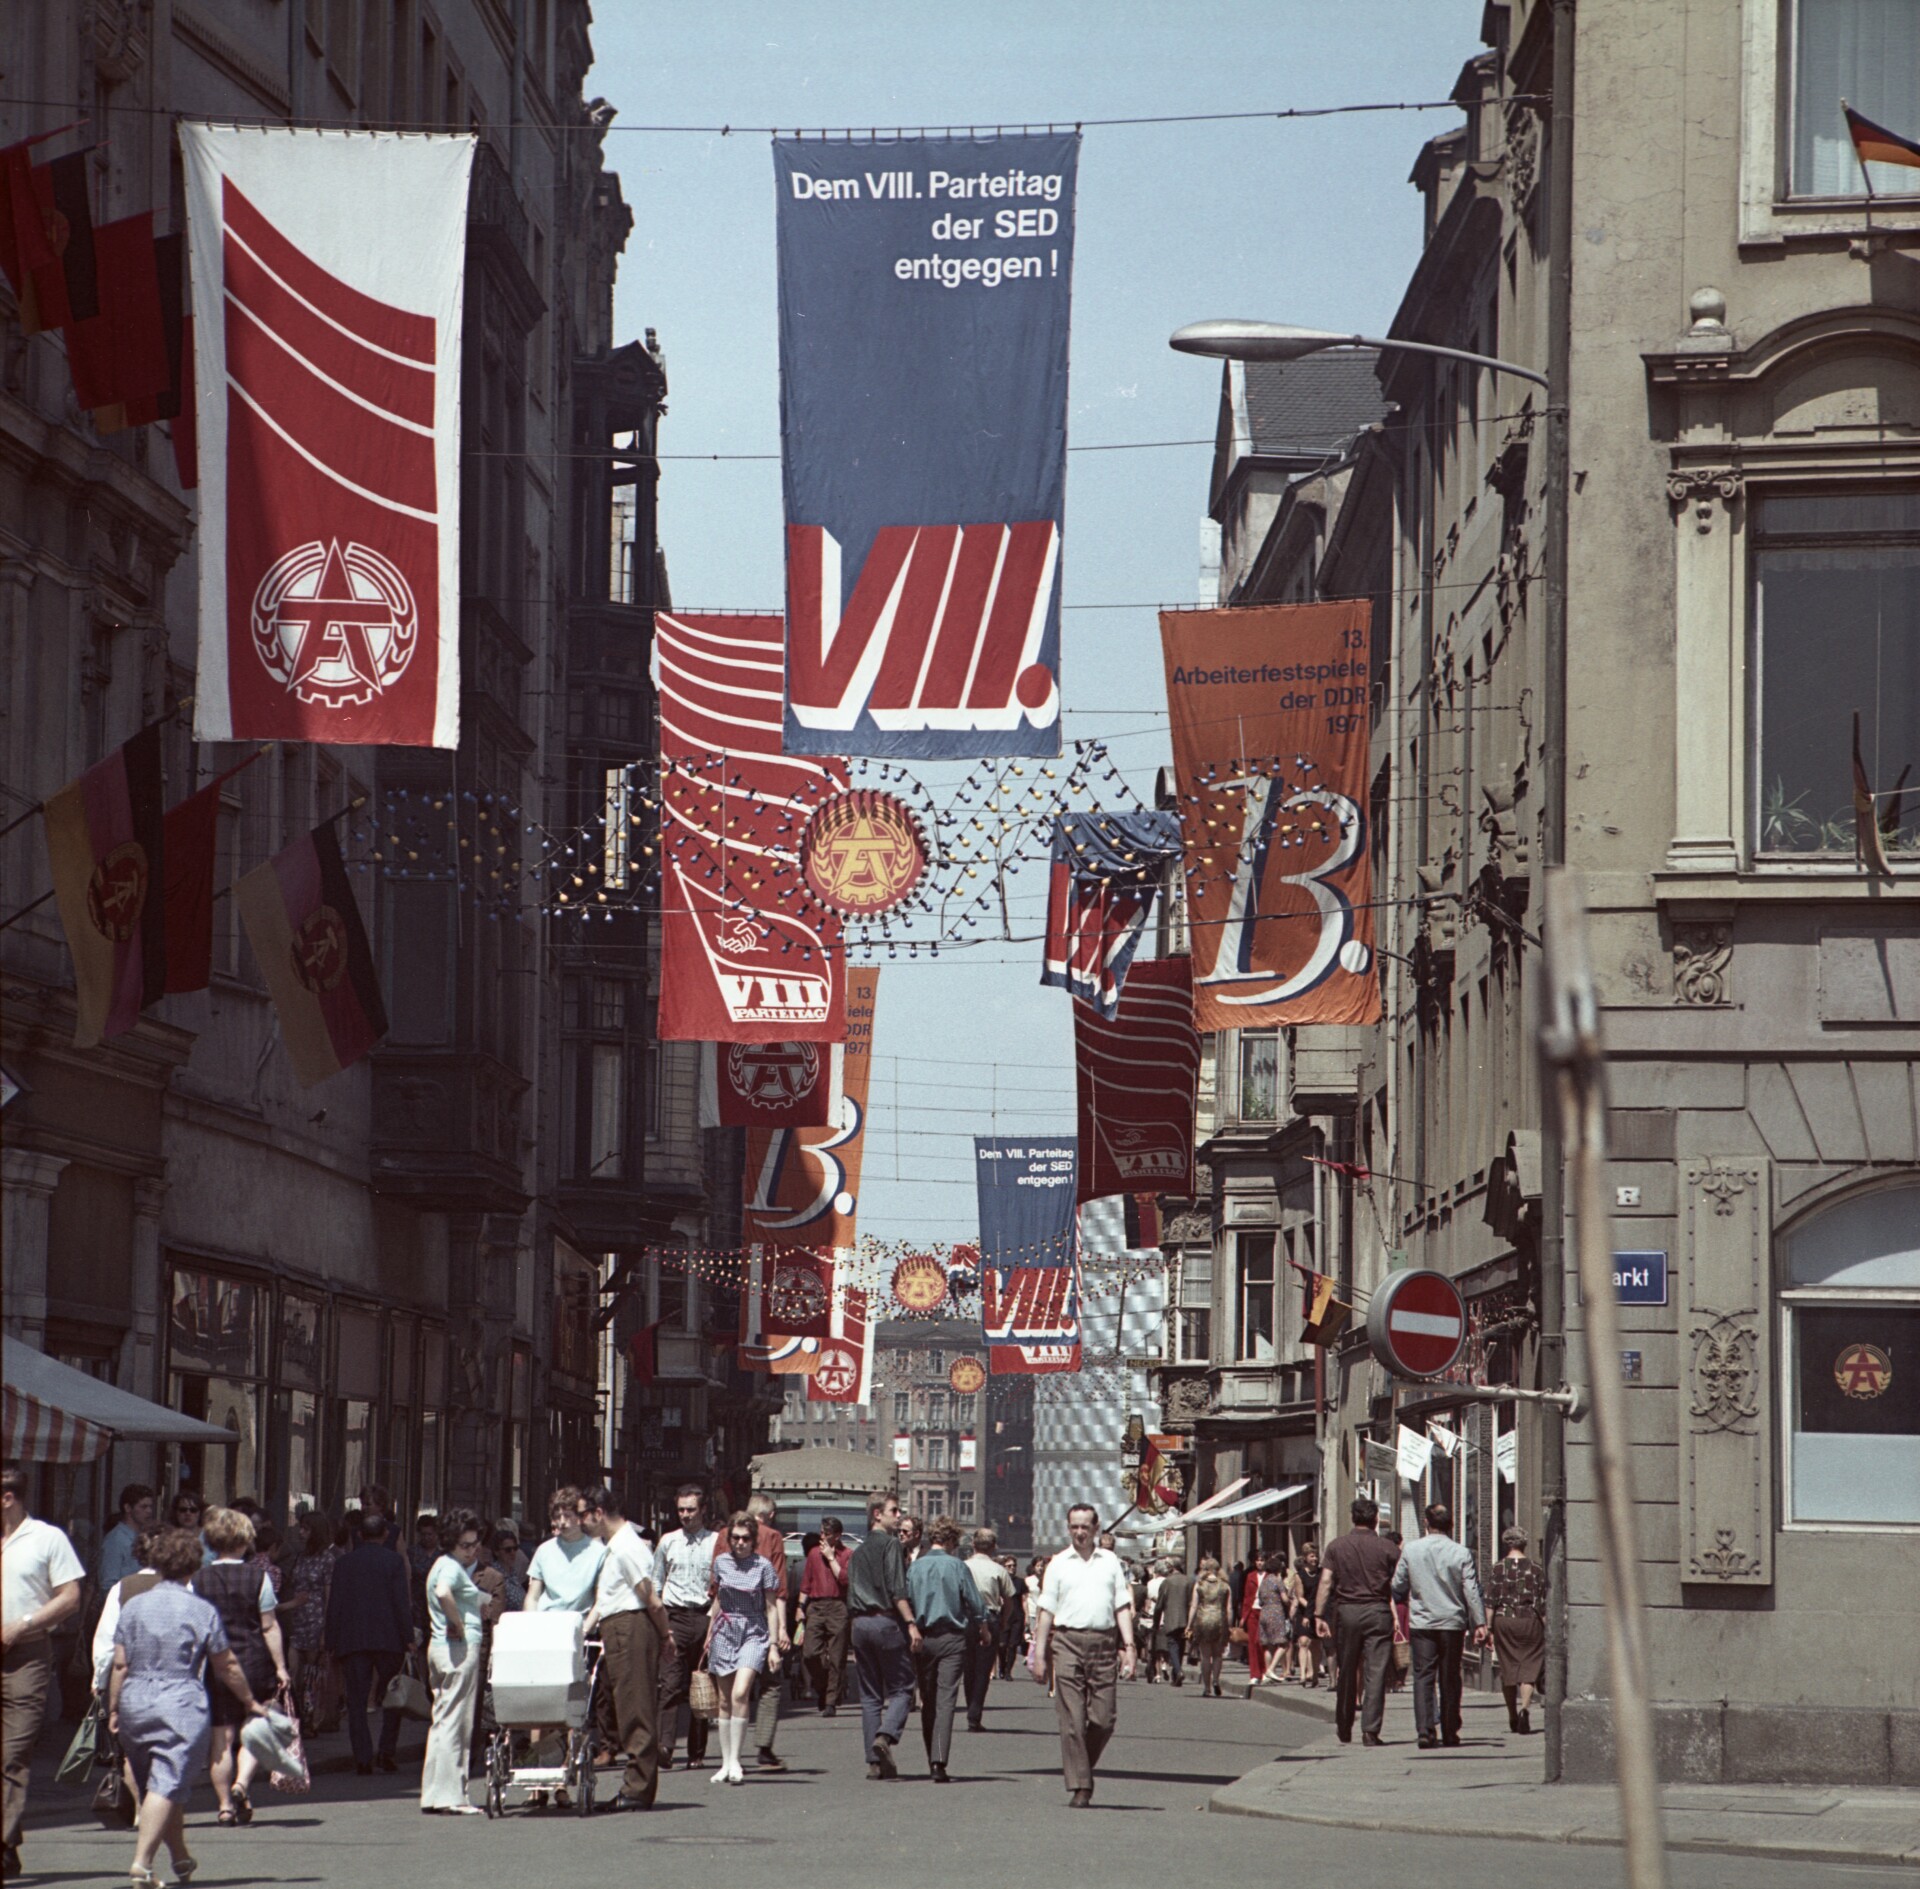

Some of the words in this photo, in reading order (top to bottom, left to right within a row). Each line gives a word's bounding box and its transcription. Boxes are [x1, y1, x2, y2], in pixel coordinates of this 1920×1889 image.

[791, 171, 860, 199] Dem
[865, 171, 922, 199] VIII.
[929, 169, 1063, 201] Parteitag
[931, 213, 984, 240] der
[994, 208, 1059, 238] SED
[894, 253, 1042, 288] entgegen
[788, 520, 1060, 731] VIII.
[1341, 629, 1367, 649] 13.
[1173, 657, 1367, 685] Arbeiterfestspiele
[1280, 692, 1316, 710] der
[1324, 686, 1366, 707] DDR
[1326, 714, 1365, 735] 197
[1194, 775, 1372, 1005] 13.
[719, 974, 827, 1007] VIII
[733, 1008, 826, 1019] PARTEITAG
[979, 1148, 1003, 1159] Dem
[1005, 1148, 1027, 1159] VIII.
[1028, 1148, 1074, 1160] Parteitag
[1115, 1151, 1185, 1169] VIII
[1028, 1162, 1047, 1172] der
[1050, 1161, 1073, 1172] SED
[1017, 1174, 1068, 1188] entgegen
[1611, 1267, 1649, 1287] arkt
[983, 1267, 1077, 1338] VIII.
